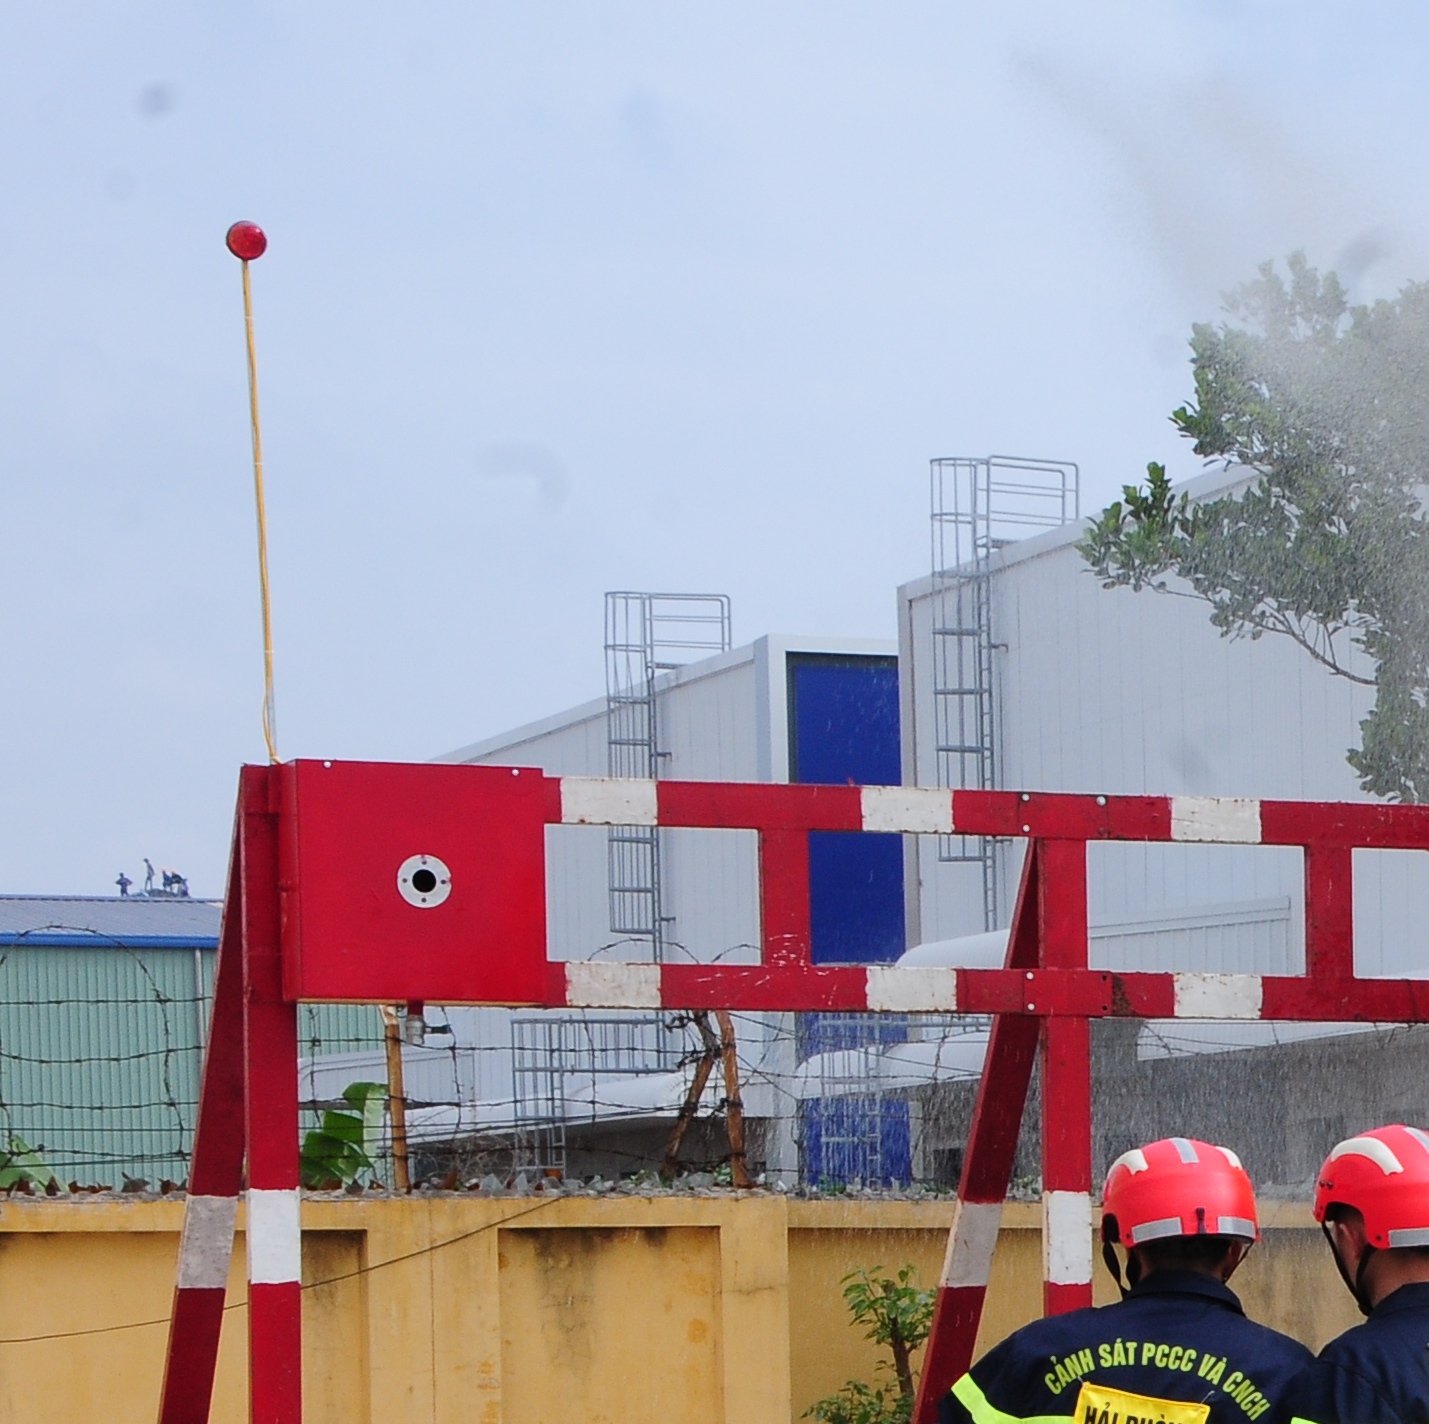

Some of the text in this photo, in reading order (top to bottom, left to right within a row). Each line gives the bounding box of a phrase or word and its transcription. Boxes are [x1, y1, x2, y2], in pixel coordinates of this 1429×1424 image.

[1044, 1338, 1271, 1421] CẢNH SÁT PCCC VÀ CNCH
